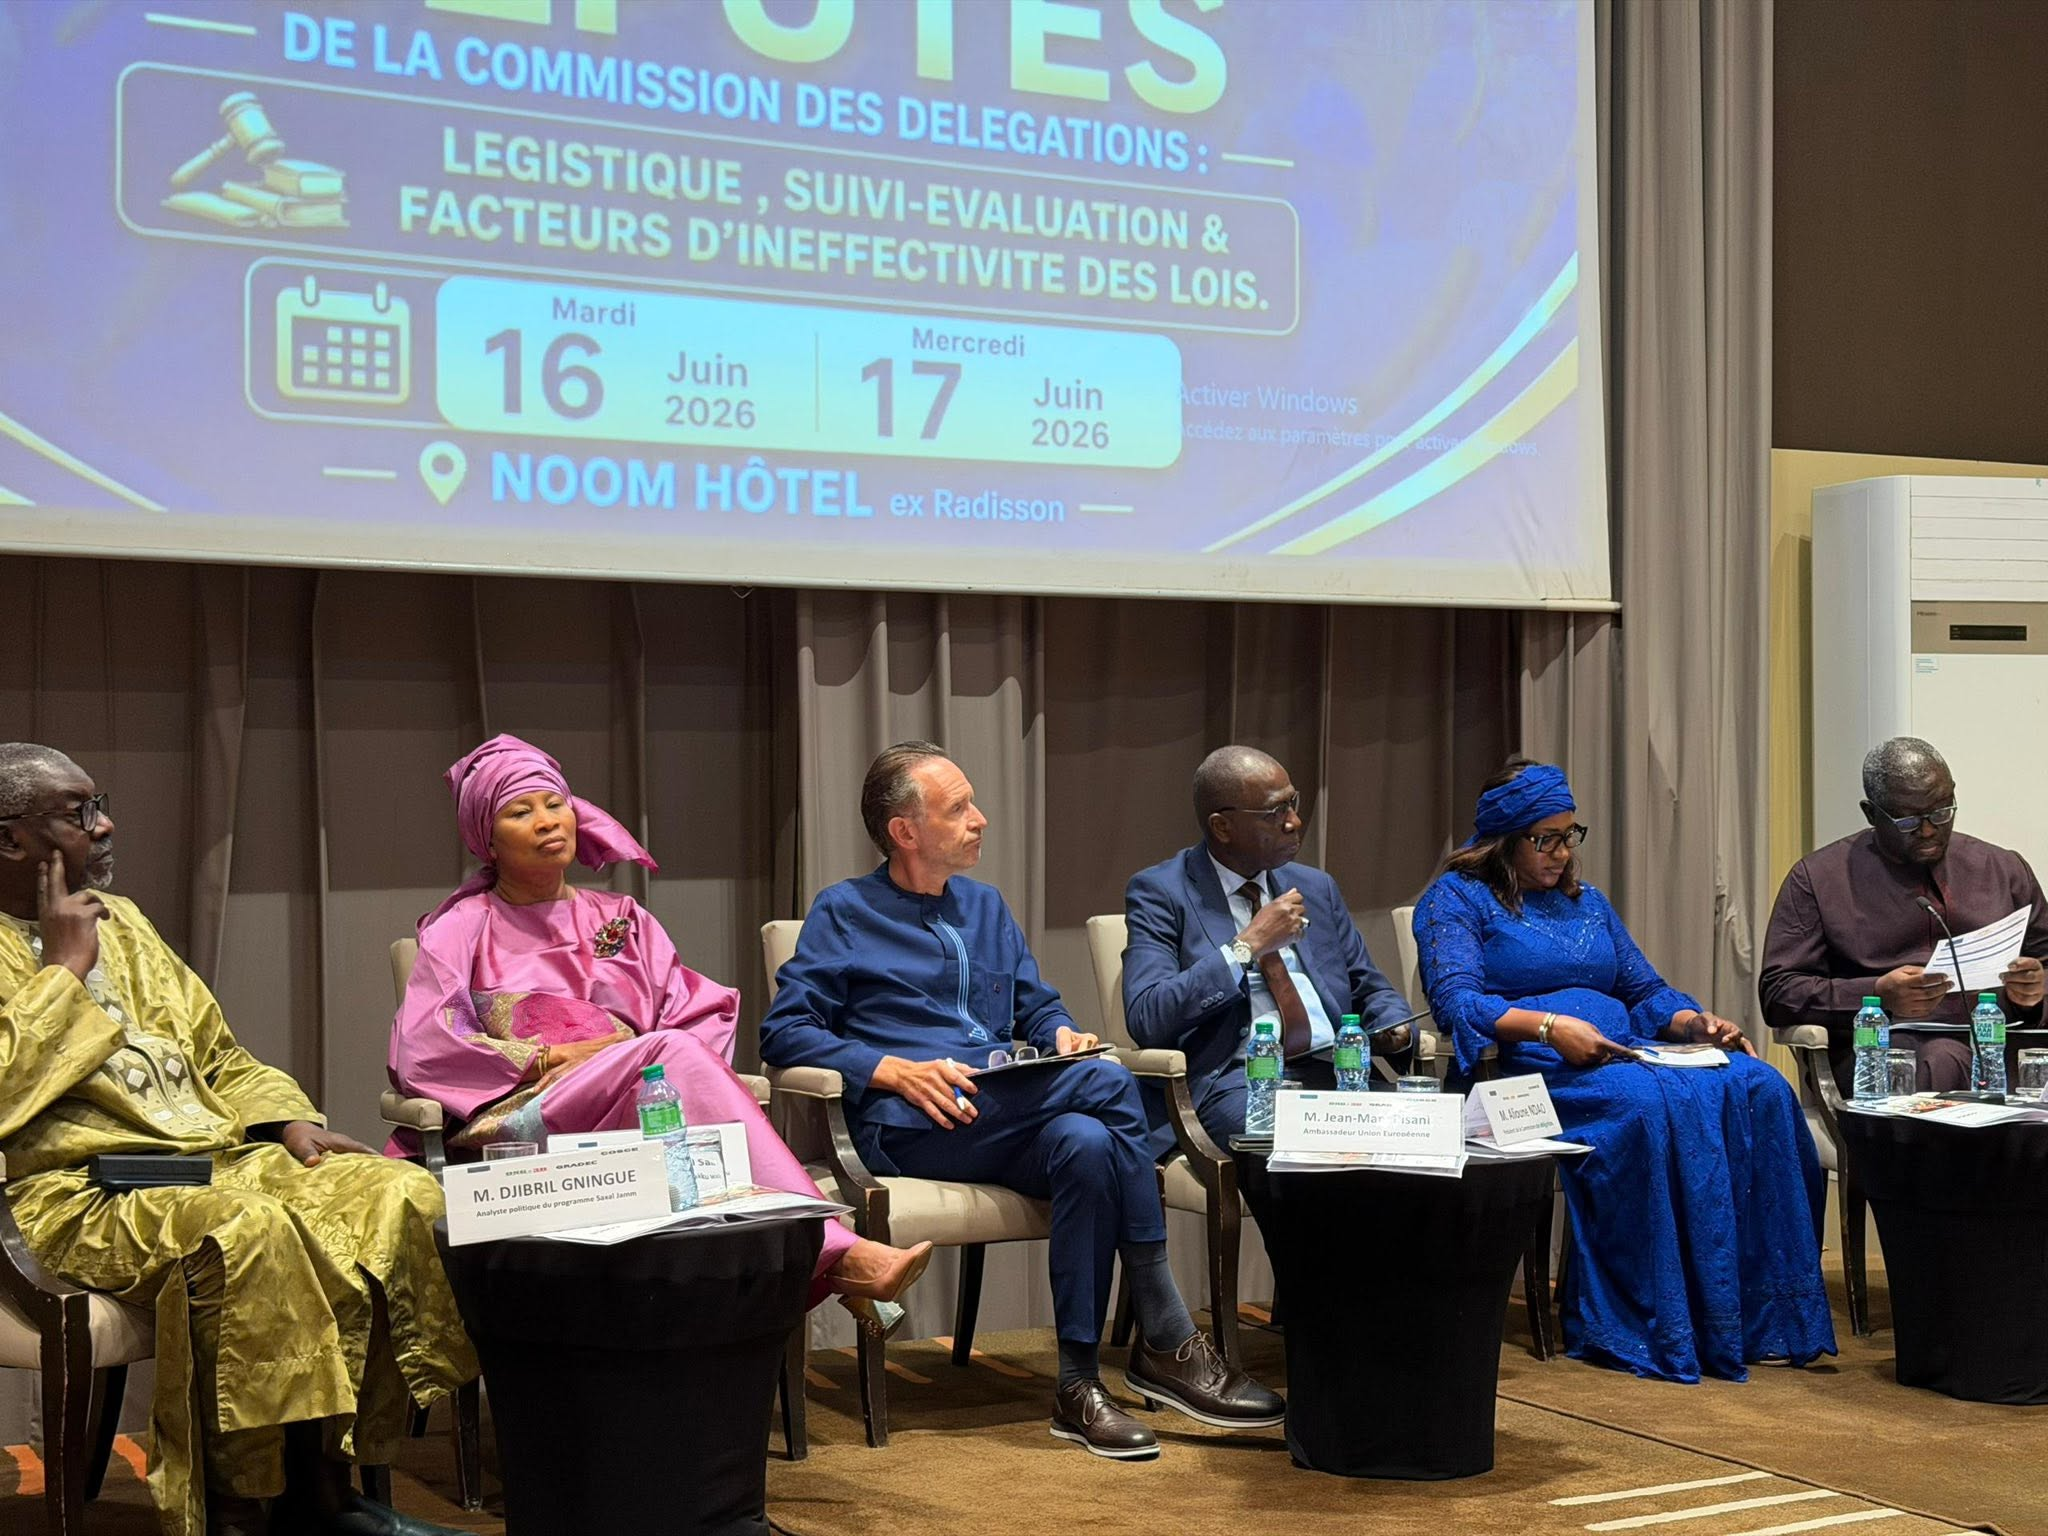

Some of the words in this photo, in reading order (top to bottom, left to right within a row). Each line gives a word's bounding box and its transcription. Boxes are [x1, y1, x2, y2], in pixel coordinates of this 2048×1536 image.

[284, 11, 357, 69] DE
[373, 24, 443, 81] LA
[454, 36, 781, 124] COMMISSION
[795, 82, 885, 138] DES
[443, 126, 743, 205] LEGISTIQUE
[783, 167, 1190, 251] SUIVI-EVALUATION
[1199, 212, 1230, 255] &
[398, 185, 673, 258] FACTEURS
[687, 216, 1066, 296] D’INEFFECTIVITE
[1077, 255, 1159, 302] DES
[1169, 264, 1270, 311] LOIS.
[551, 296, 637, 327] Mardi
[912, 326, 1026, 358] Mercredi
[484, 327, 605, 421] 16
[666, 350, 749, 388] Juin
[861, 357, 962, 440] 17
[1032, 376, 1104, 412] Juin
[1179, 381, 1252, 410] Activer
[1256, 383, 1359, 416] Windows
[664, 395, 757, 430] 2026
[1031, 418, 1110, 450] 2026
[491, 451, 676, 511] NOOM
[695, 455, 874, 518] HÔTEL
[889, 493, 925, 517] ex
[934, 489, 1066, 522] Radisson
[1303, 1127, 1357, 1137] Ambassadeur
[1358, 1129, 1382, 1137] Union
[1304, 1111, 1321, 1123] M.
[1324, 1111, 1385, 1124] Jean-Mar
[555, 1160, 598, 1170] GRADEC
[473, 1189, 495, 1204] M.
[500, 1181, 558, 1199] DJIBRIL
[561, 1169, 637, 1192] GNINGUE
[476, 1206, 508, 1218] Analyste
[508, 1202, 541, 1214] politique
[542, 1201, 552, 1209] du
[553, 1196, 595, 1209] programme
[596, 1192, 615, 1202] Saxal
[616, 1190, 637, 1200] Jamm
